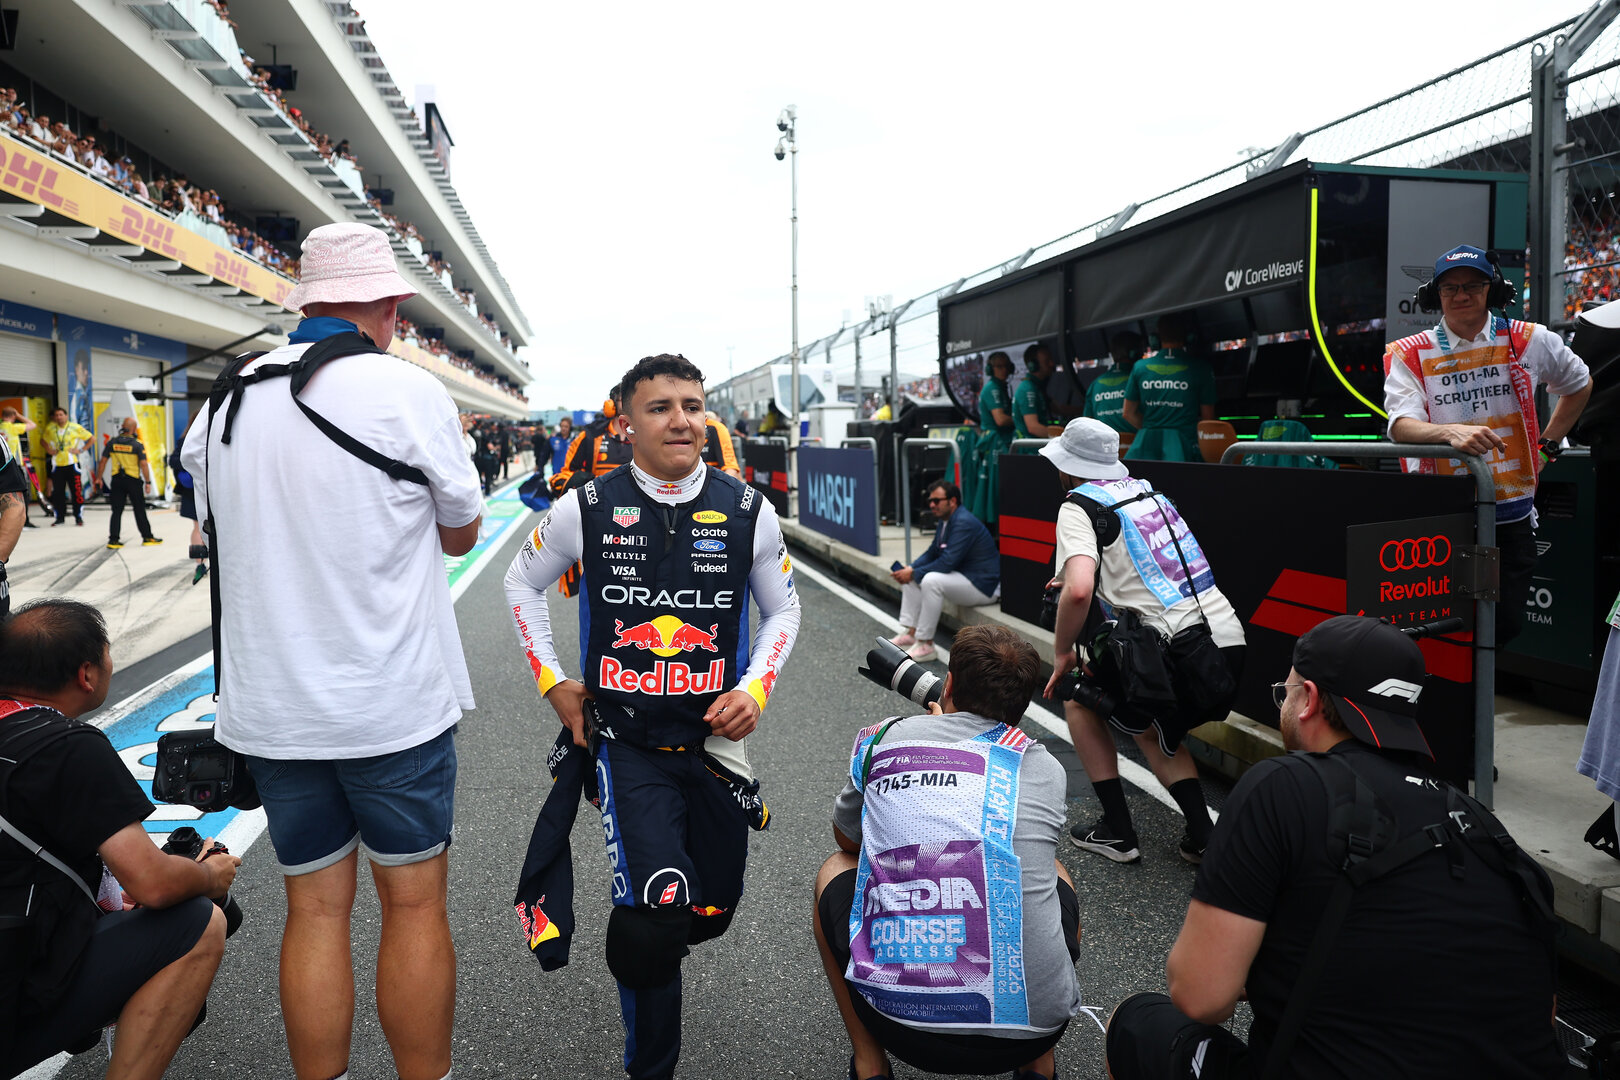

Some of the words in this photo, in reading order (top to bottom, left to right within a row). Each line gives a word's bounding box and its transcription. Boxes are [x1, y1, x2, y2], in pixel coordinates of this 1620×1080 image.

[121, 205, 177, 257] DHL
[214, 252, 252, 288] DHL
[1245, 260, 1304, 285] CoreWeave
[1095, 390, 1126, 402] aramc
[1142, 380, 1188, 391] aramco
[1472, 400, 1488, 413] F1
[807, 471, 855, 529] MARSH
[614, 516, 639, 527] HEUER
[700, 528, 729, 537] Gate
[602, 534, 635, 546] Mobil
[636, 536, 647, 546] 1
[699, 541, 720, 550] Ford
[602, 552, 647, 561] CARLYLE
[693, 562, 728, 573] indeed
[610, 565, 637, 576] VISA
[1136, 557, 1174, 600] MIAMI
[601, 584, 734, 609] ORACLE
[1380, 575, 1450, 602] Revolut
[1409, 607, 1450, 622] TEAM
[1526, 611, 1552, 626] TEAM
[600, 656, 665, 694] Red
[667, 657, 725, 695] Bull
[896, 756, 911, 764] FIA
[875, 772, 958, 796] 1745-MIA
[984, 764, 1012, 840] MIAMI
[864, 877, 984, 918] MEDIA
[514, 901, 526, 925] Red
[871, 918, 964, 946] COURSE
[877, 945, 954, 959] ACCESS
[996, 942, 1007, 977] ROUND
[1006, 943, 1024, 994] 2026
